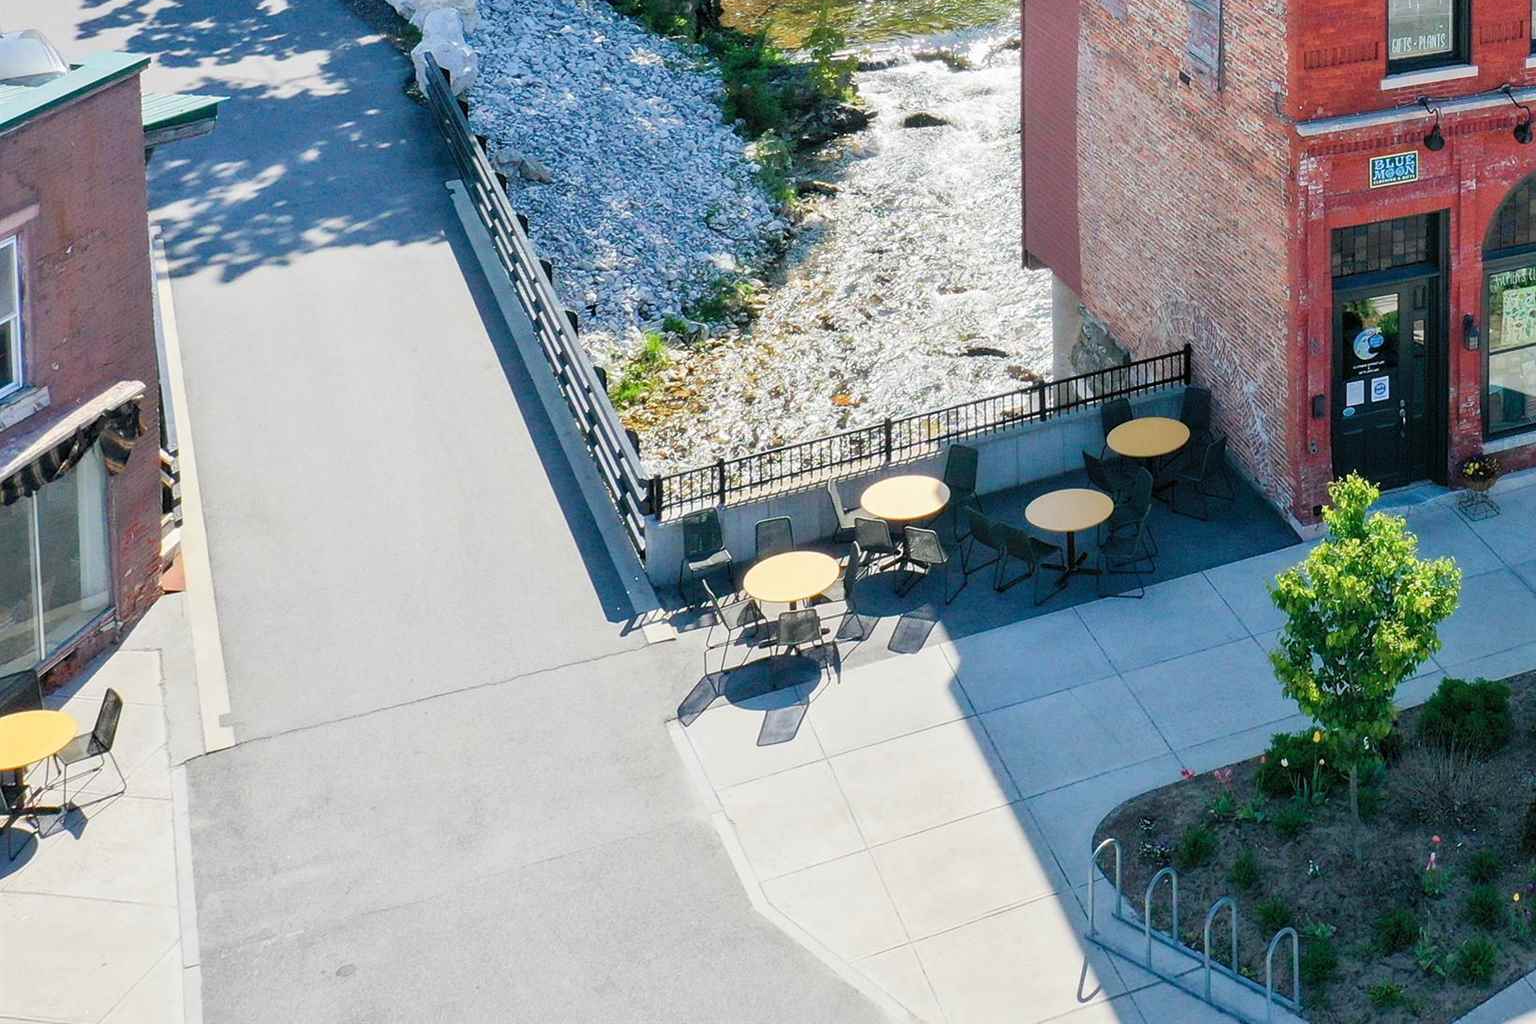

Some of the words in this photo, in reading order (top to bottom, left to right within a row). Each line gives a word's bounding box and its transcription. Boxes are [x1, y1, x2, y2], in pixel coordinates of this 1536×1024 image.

[1418, 32, 1446, 50] PLANTS
[1375, 154, 1416, 170] BLUE
[1373, 164, 1416, 181] MOON
